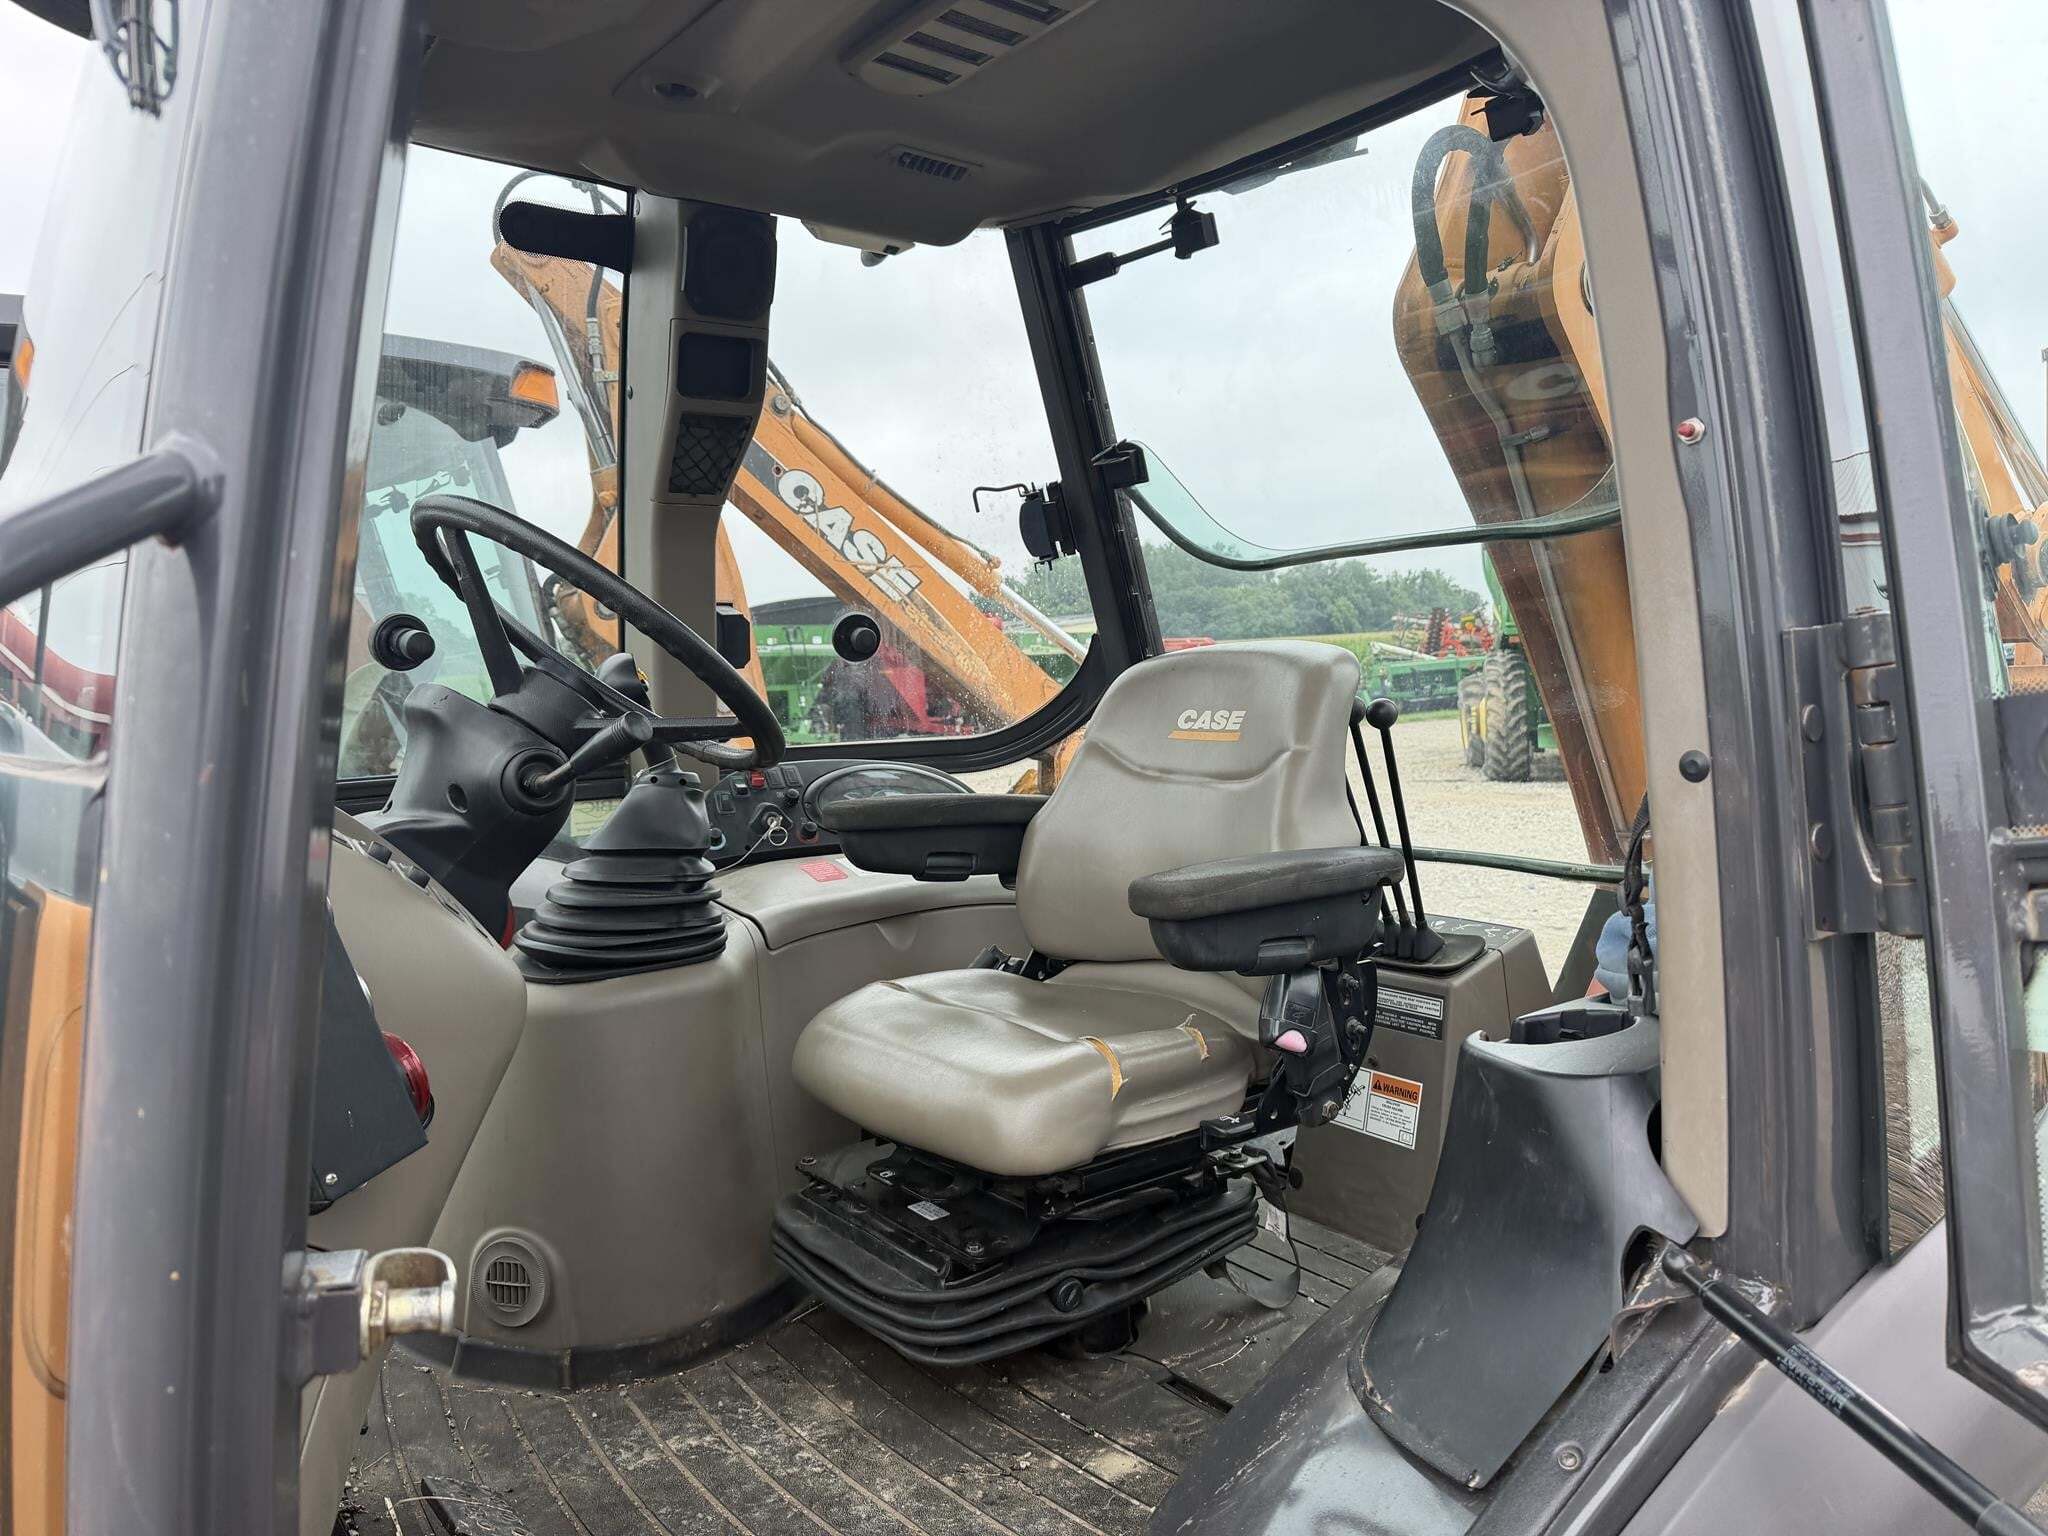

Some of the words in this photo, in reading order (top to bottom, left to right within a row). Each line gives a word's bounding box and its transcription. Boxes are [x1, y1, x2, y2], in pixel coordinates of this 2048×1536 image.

[778, 469, 923, 602] CASE
[1177, 709, 1247, 730] CASE
[1382, 1082, 1418, 1102] WARNING
